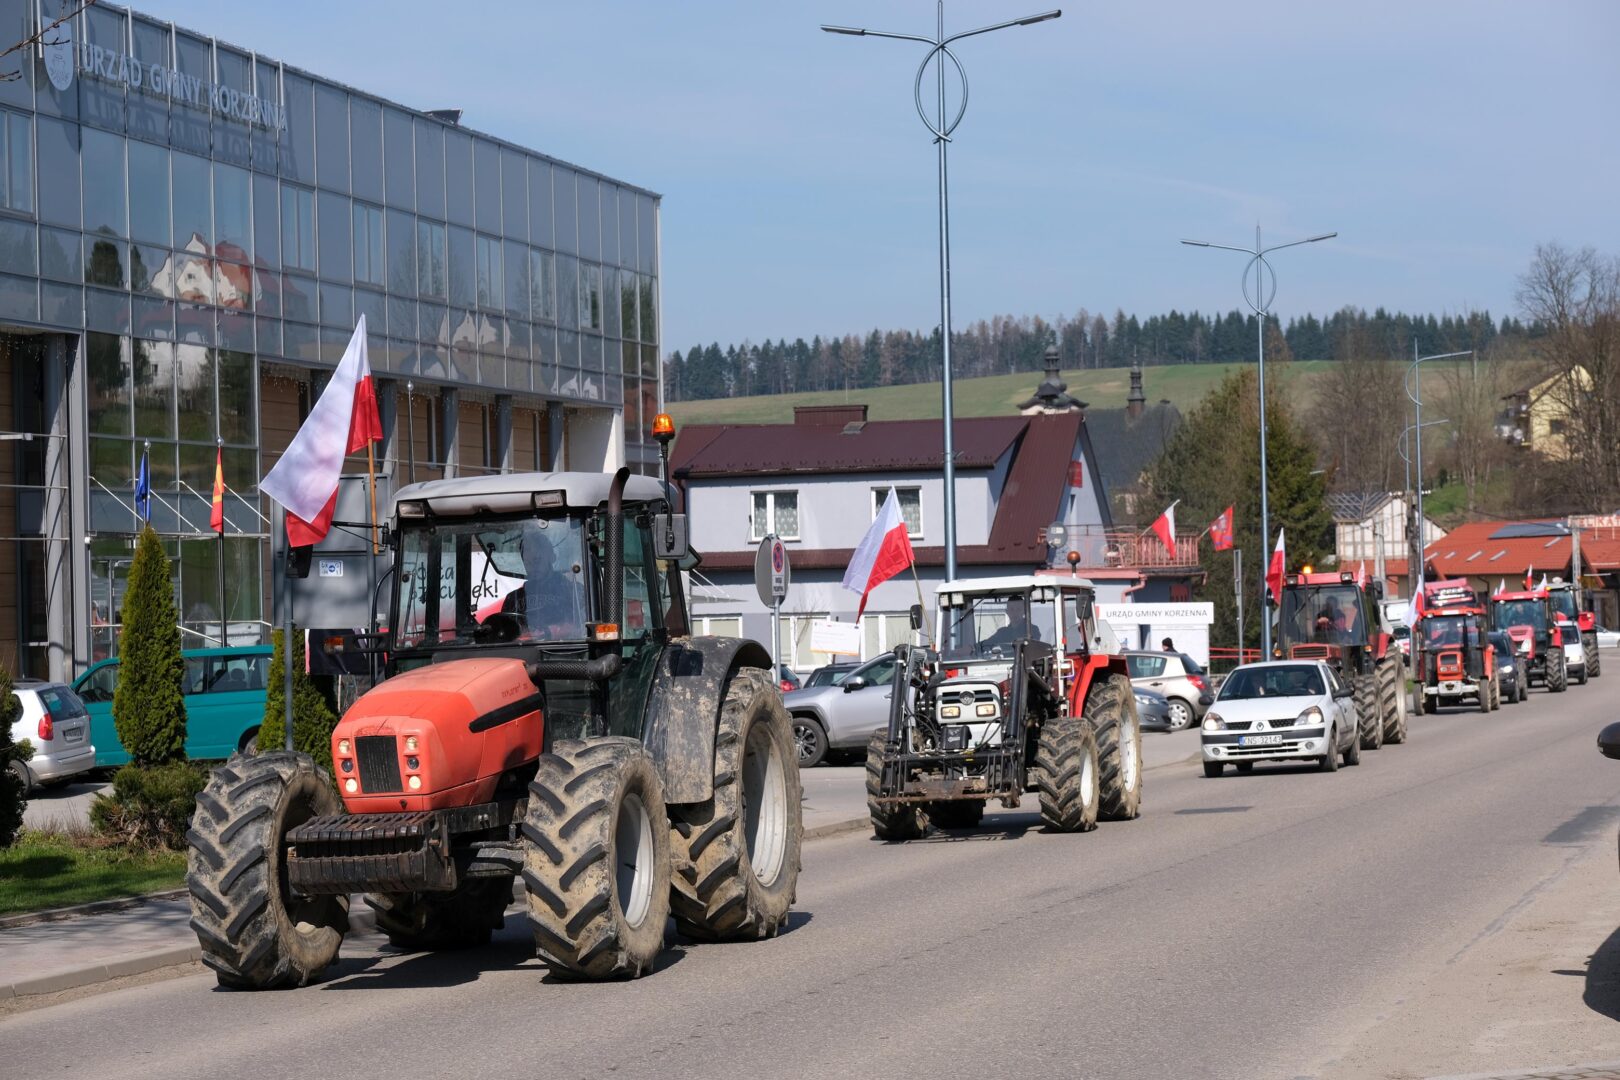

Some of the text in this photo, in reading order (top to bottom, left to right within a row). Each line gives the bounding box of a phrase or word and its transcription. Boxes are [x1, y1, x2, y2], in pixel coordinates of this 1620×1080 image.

[150, 63, 201, 104] GMINY
[208, 83, 289, 133] KORZENNA
[1106, 610, 1133, 618] URZĄD
[1164, 609, 1208, 617] KORZENNA
